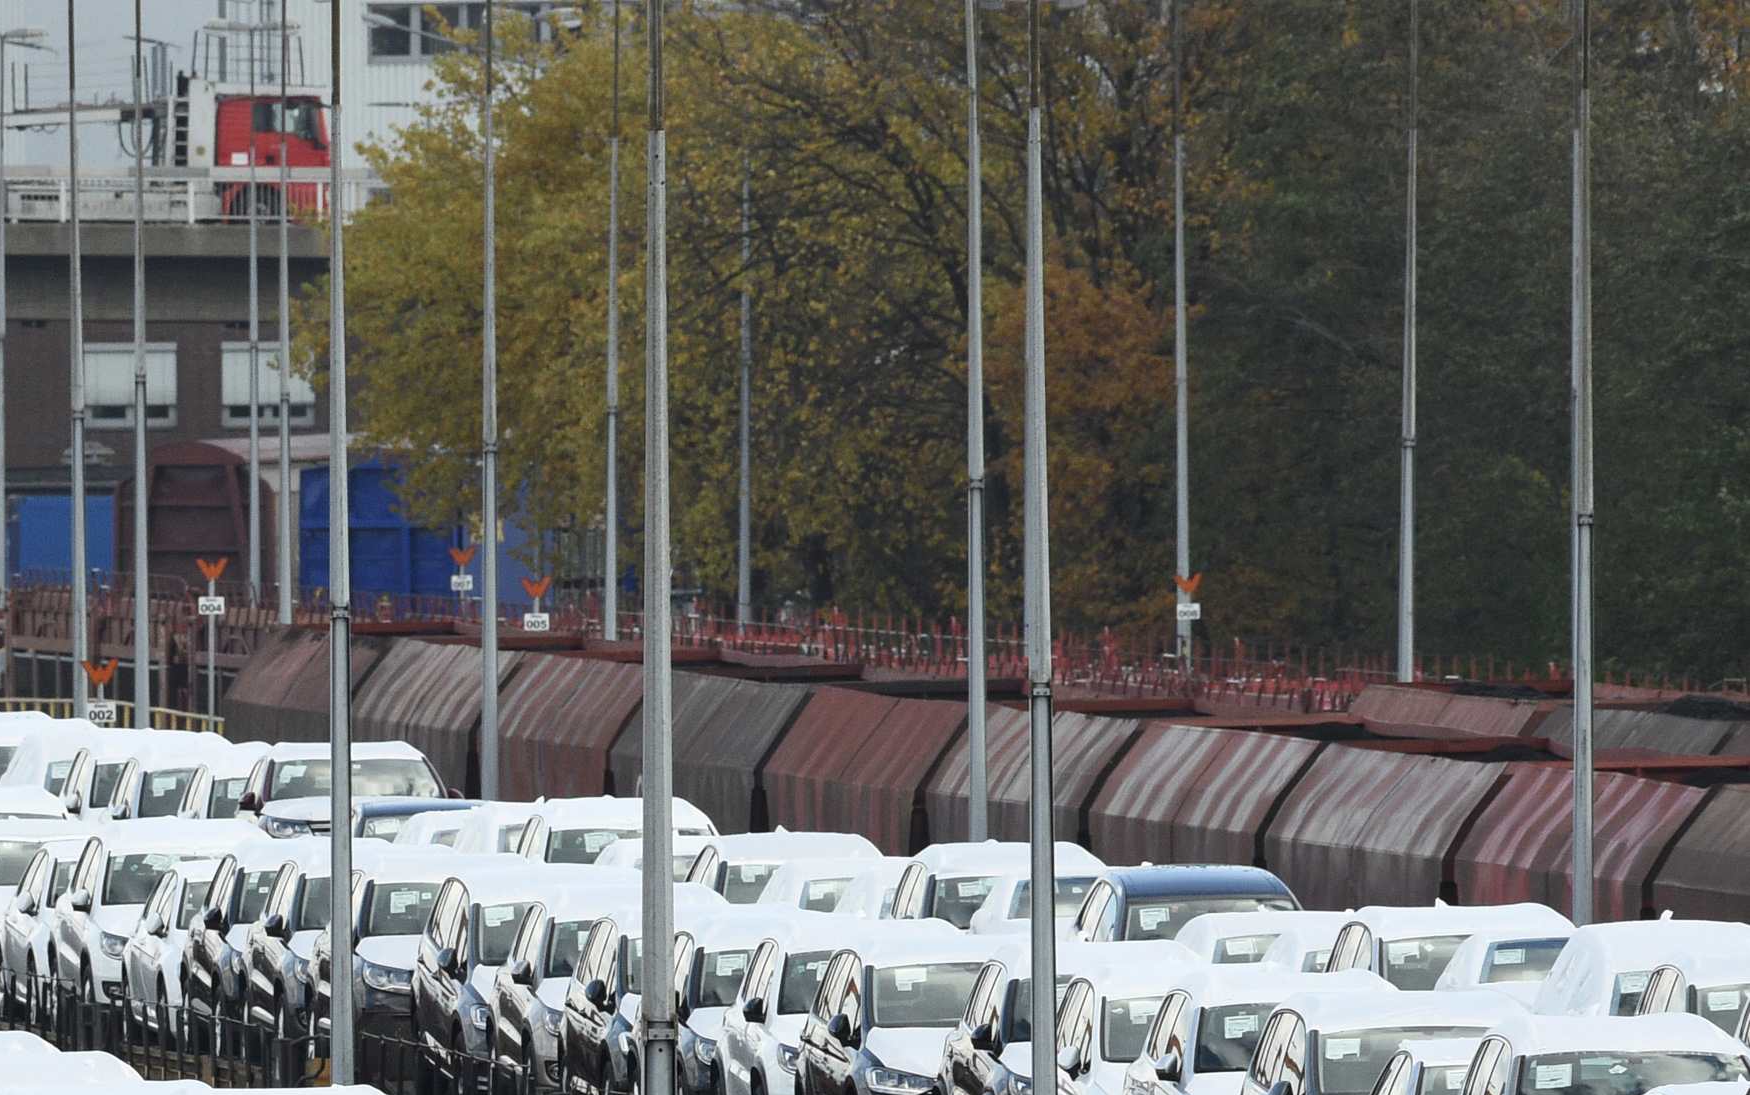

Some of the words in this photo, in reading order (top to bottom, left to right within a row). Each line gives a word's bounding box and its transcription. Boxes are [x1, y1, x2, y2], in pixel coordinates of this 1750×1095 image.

[201, 603, 222, 612] 004
[526, 620, 547, 629] 005
[89, 710, 114, 721] 002
